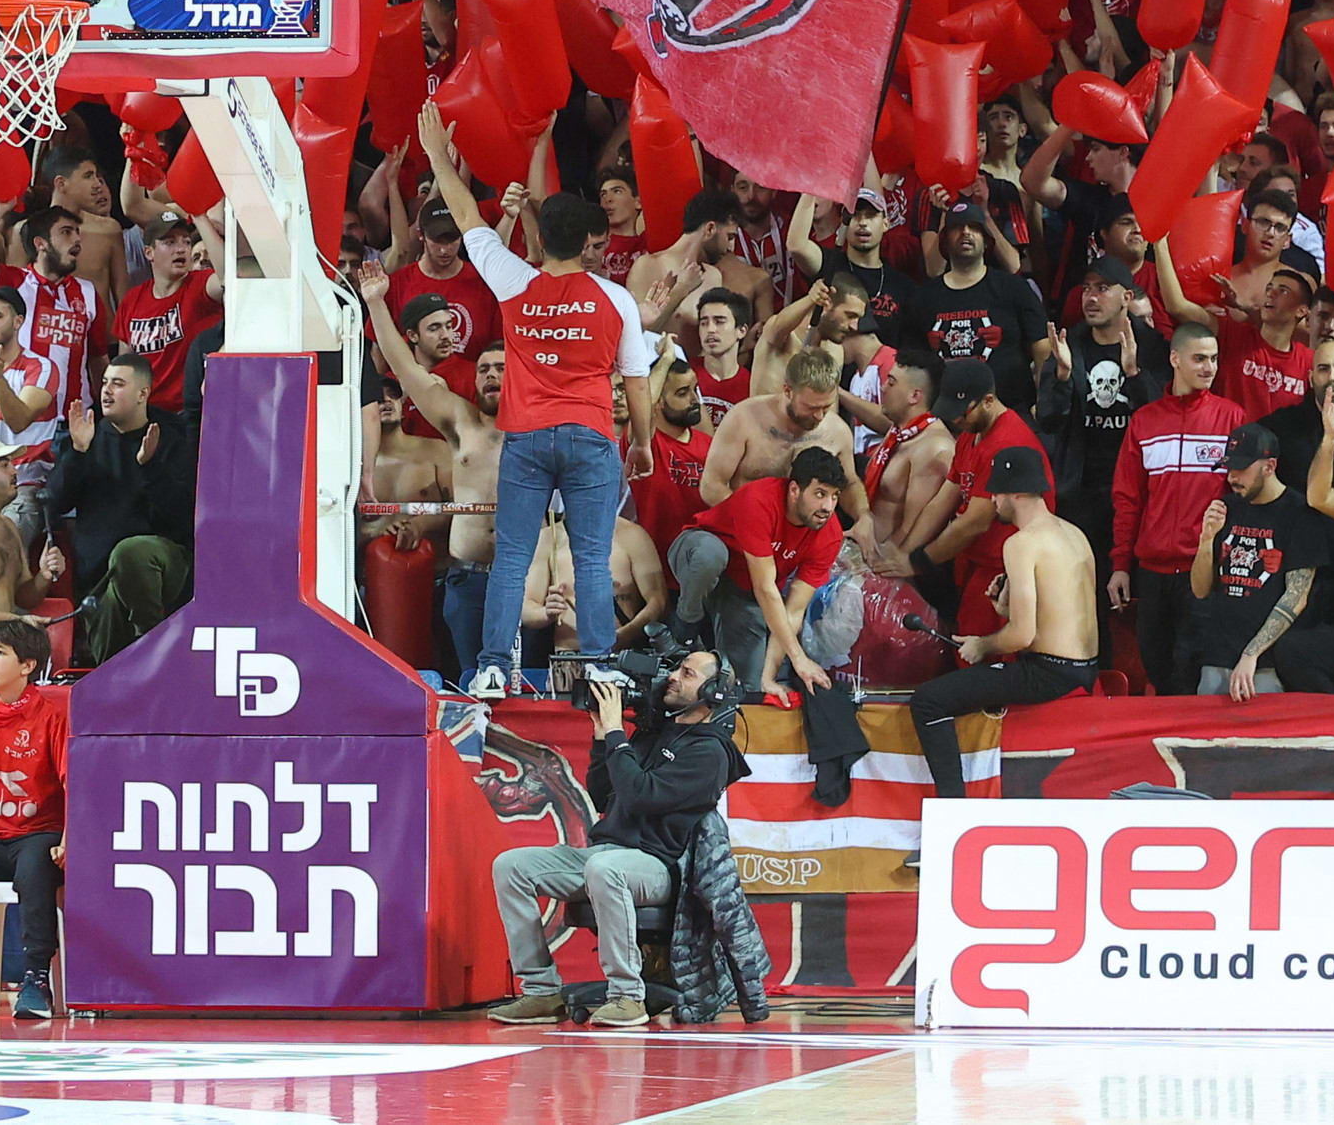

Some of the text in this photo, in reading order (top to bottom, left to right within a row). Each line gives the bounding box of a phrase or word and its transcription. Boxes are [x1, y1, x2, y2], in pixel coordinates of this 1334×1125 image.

[521, 300, 597, 318] ULTRAS
[40, 311, 85, 334] arkia
[951, 319, 972, 330] FOR
[514, 323, 594, 341] HAPOEL
[534, 352, 560, 366] 99
[1239, 535, 1257, 548] FOR
[1229, 567, 1250, 578] OUR
[113, 760, 378, 854] דלתות
[114, 863, 379, 957] תבור
[1100, 944, 1256, 981] Cloud
